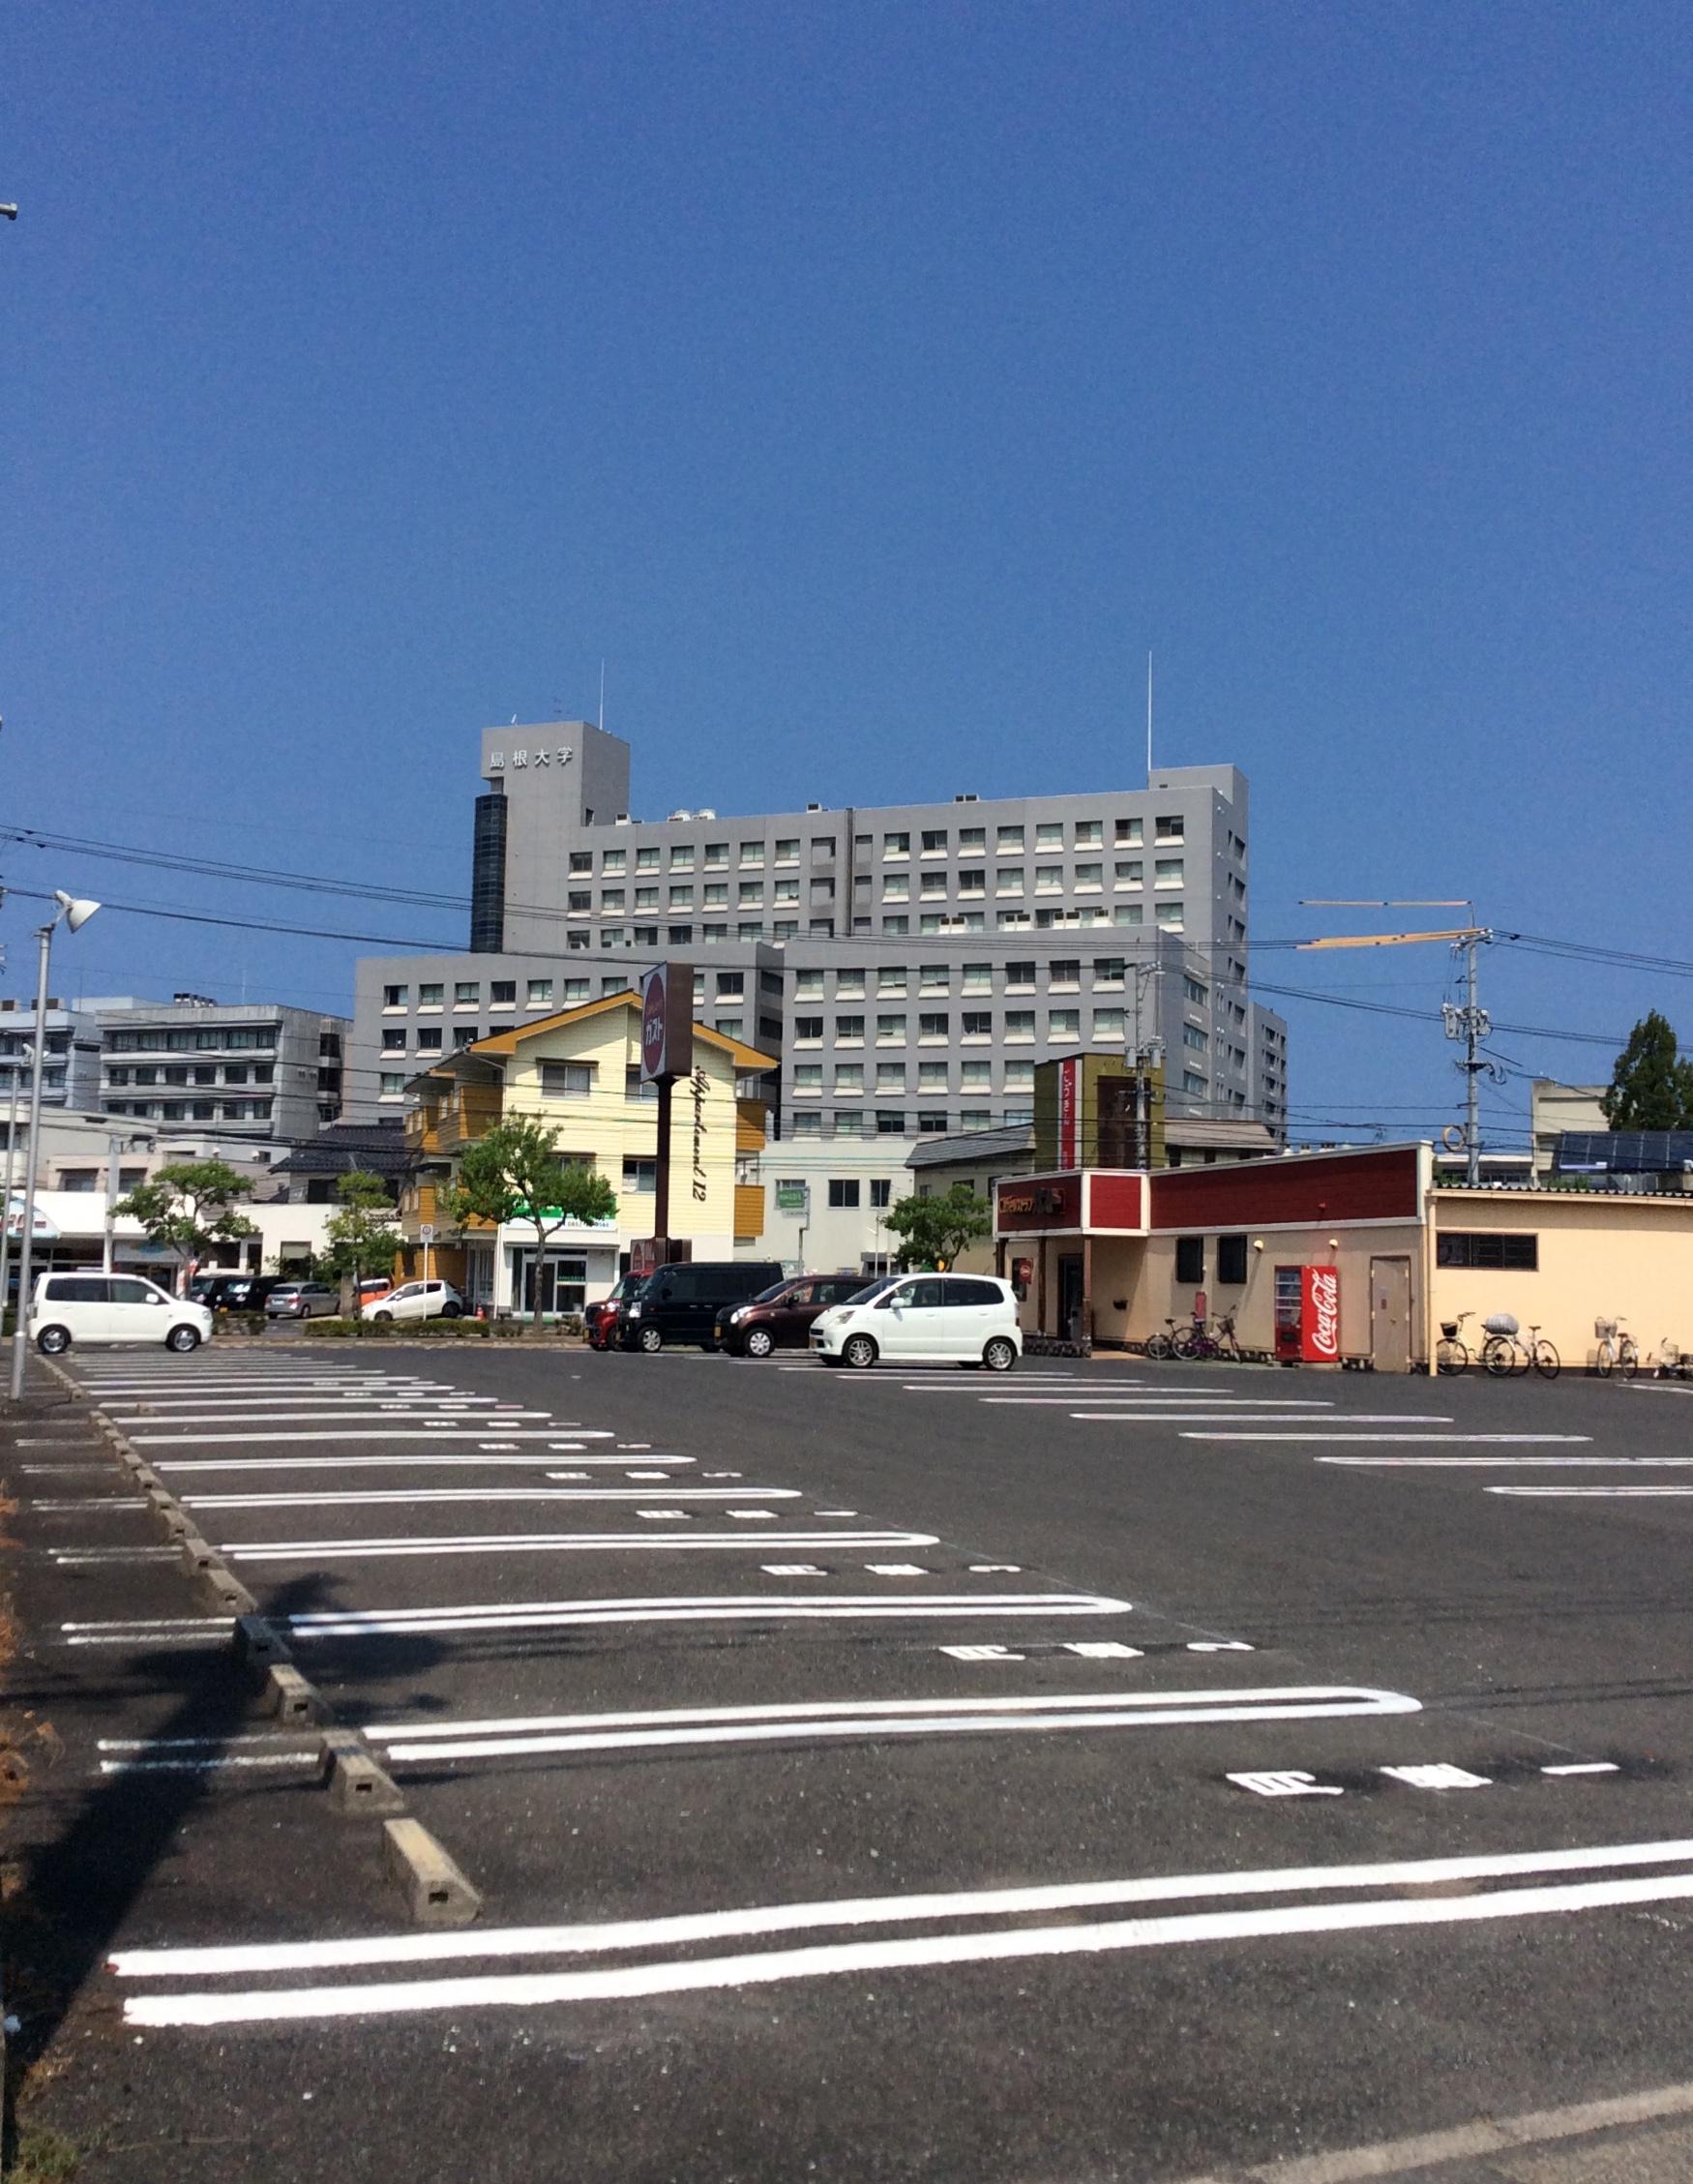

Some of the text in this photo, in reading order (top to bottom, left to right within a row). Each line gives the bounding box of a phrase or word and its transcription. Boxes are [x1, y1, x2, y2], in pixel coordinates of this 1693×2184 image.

[490, 746, 573, 768] 島根大学
[692, 1179, 707, 1202] 12
